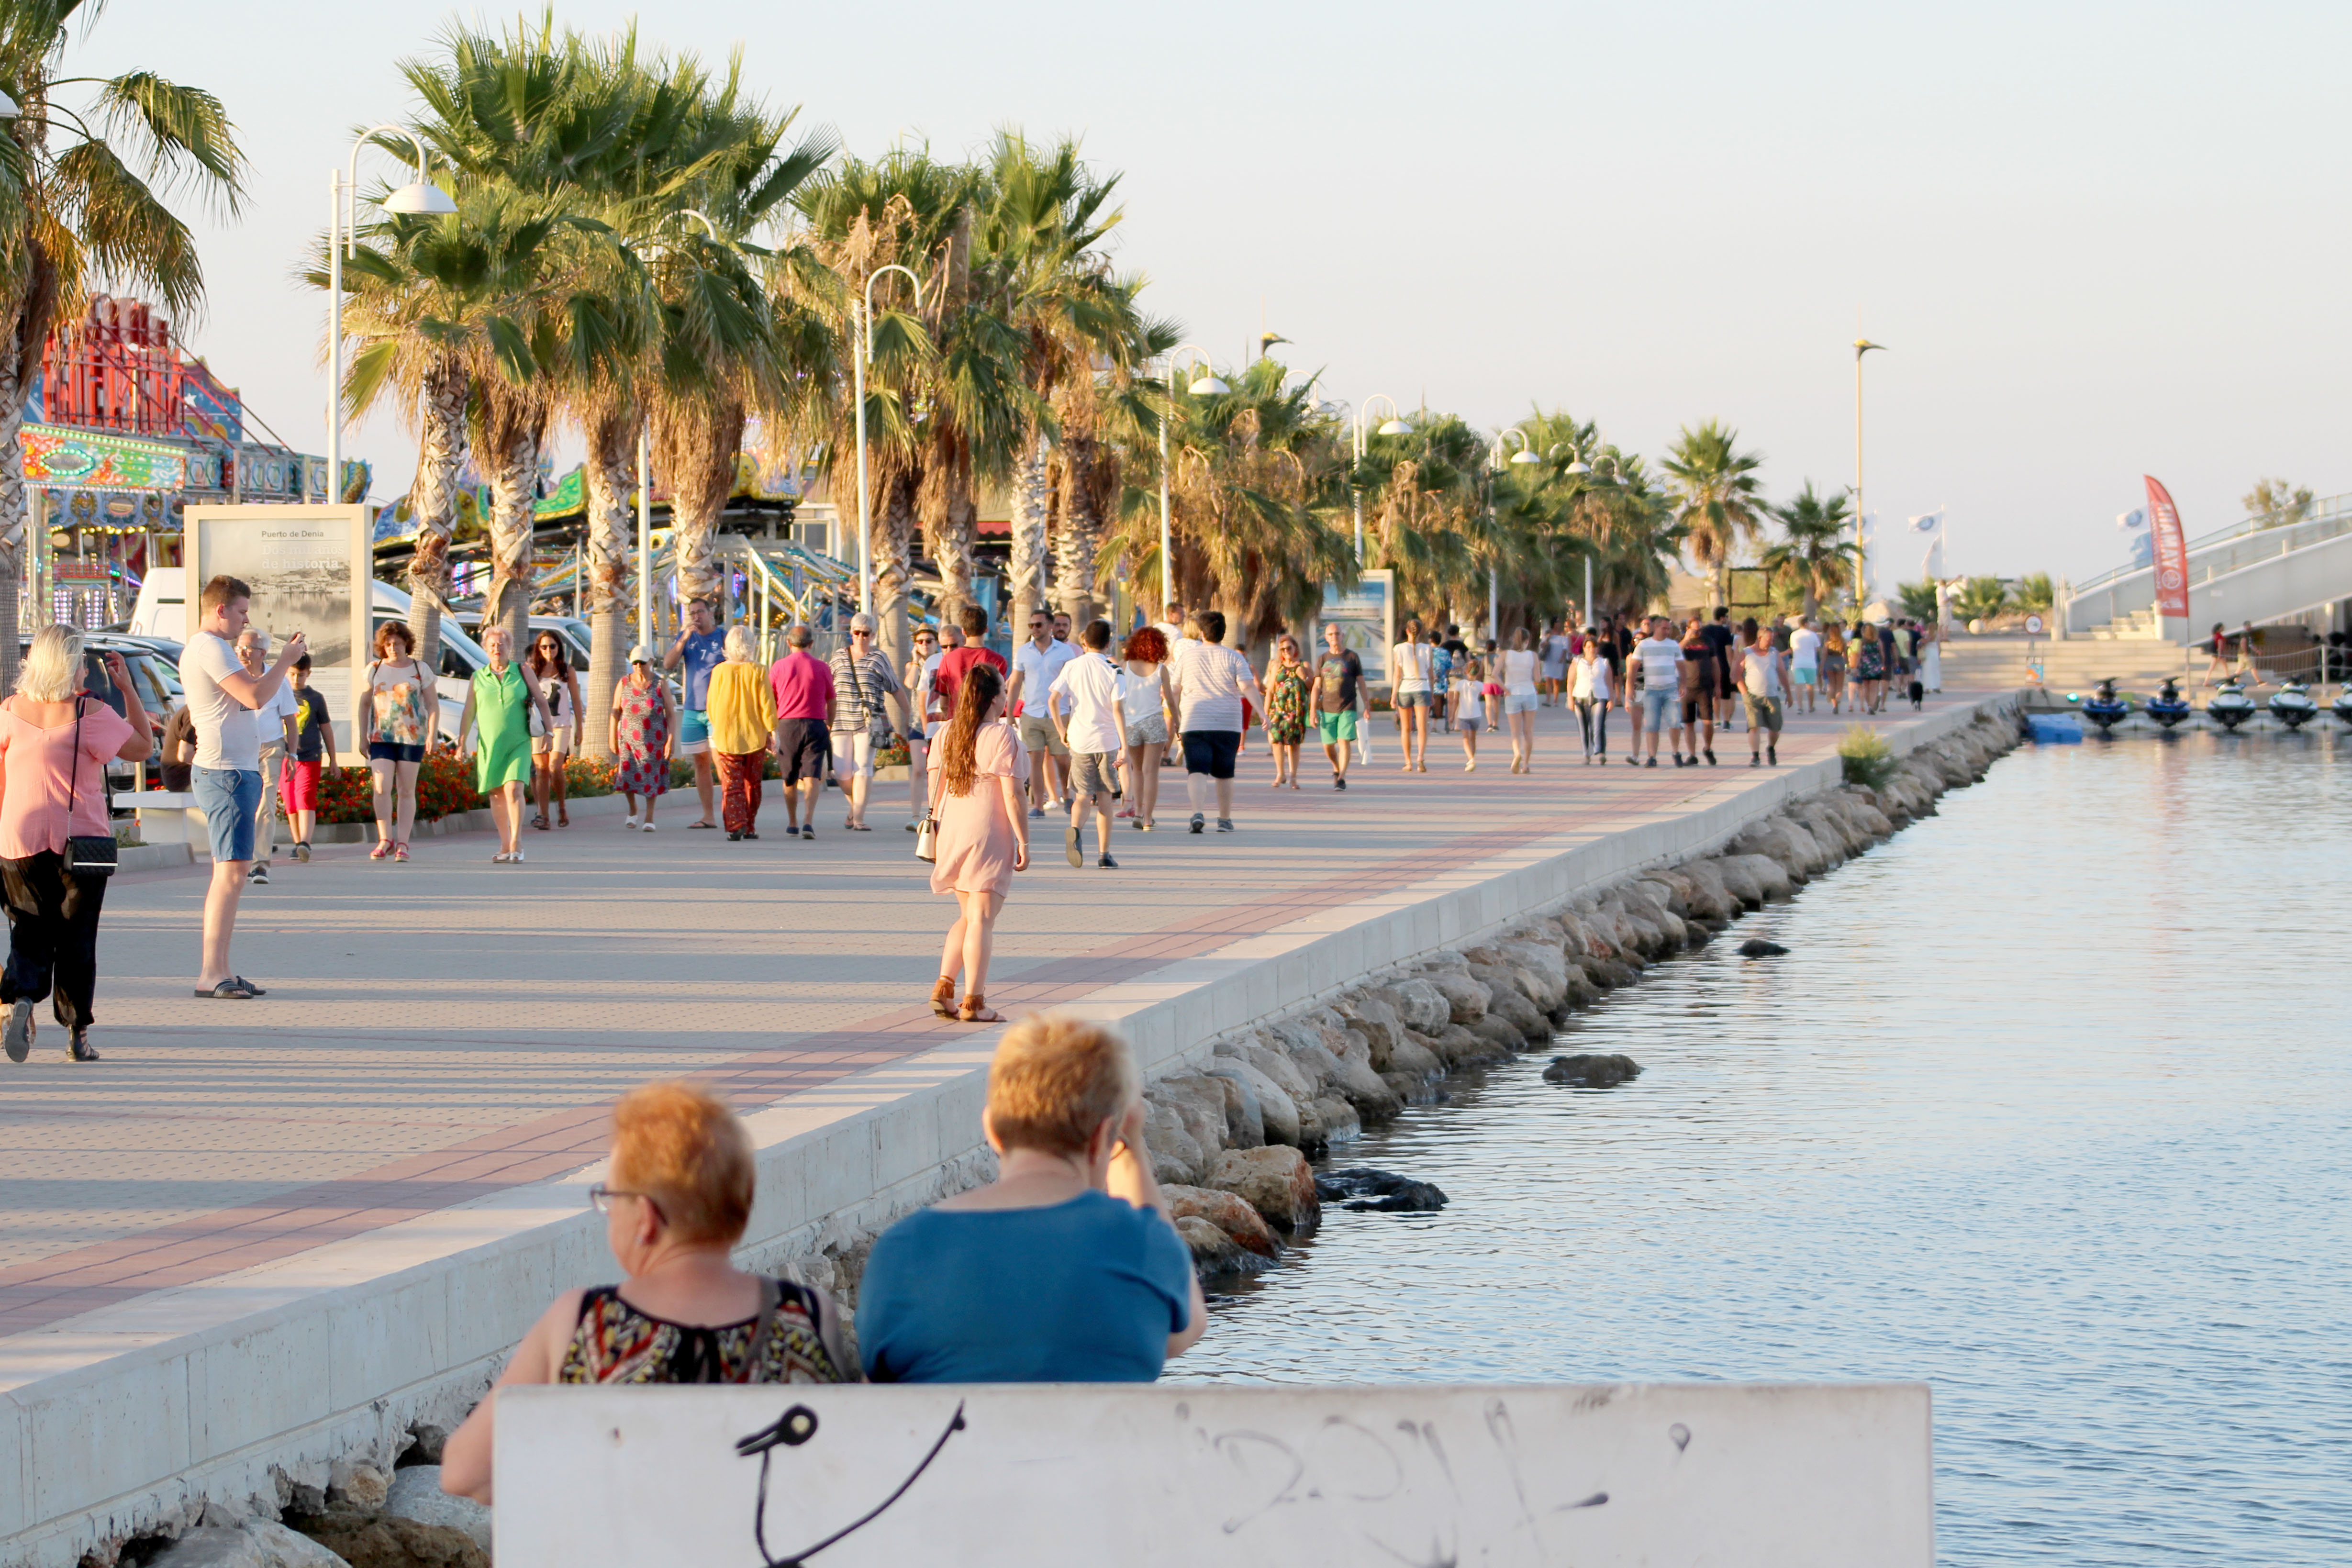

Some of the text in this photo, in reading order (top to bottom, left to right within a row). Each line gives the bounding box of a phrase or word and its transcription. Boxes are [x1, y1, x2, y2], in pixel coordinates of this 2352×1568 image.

[262, 545, 345, 555] Dos mil años
[262, 557, 339, 569] de historia
[701, 649, 707, 660] 7
